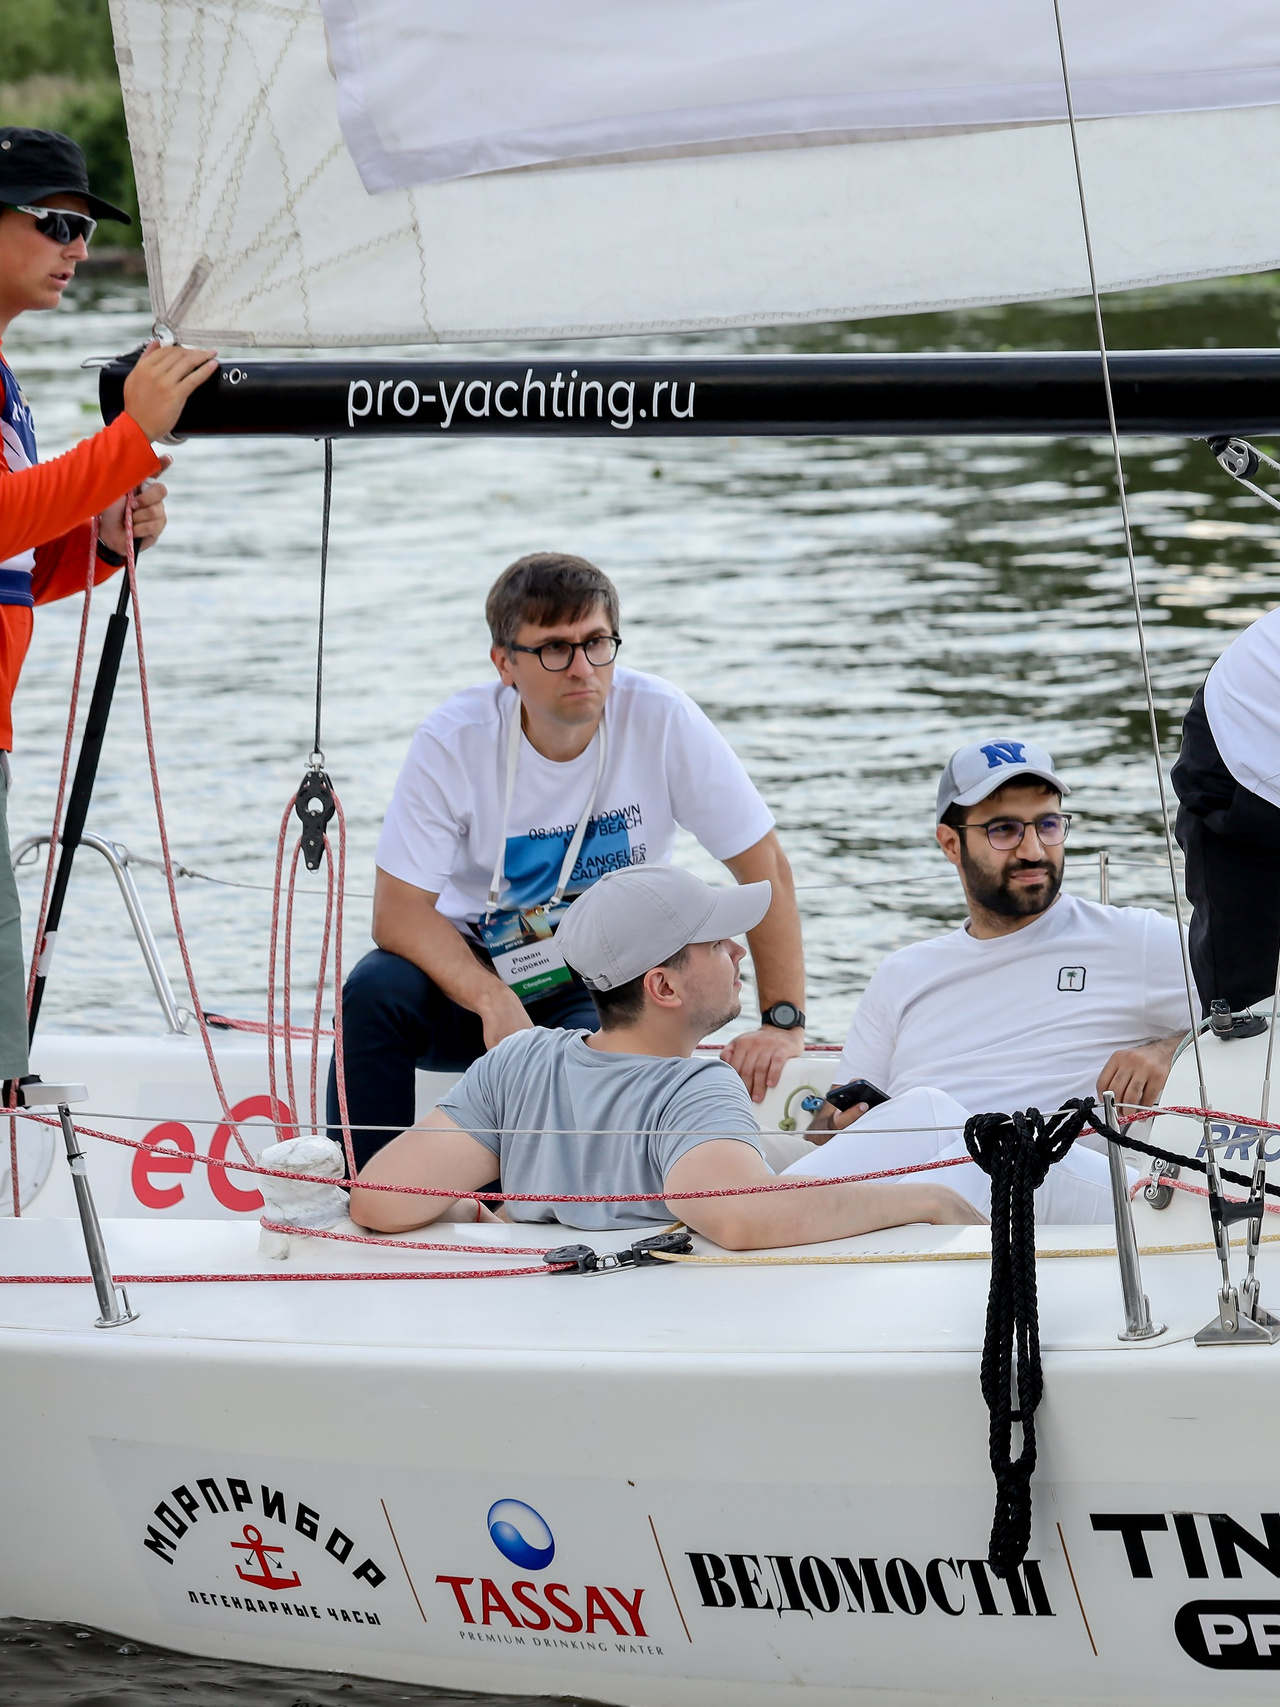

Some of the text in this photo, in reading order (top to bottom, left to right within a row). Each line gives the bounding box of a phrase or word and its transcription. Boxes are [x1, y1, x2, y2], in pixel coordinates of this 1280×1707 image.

[347, 368, 696, 430] pro-yachting.ru
[979, 742, 1027, 769] NY
[528, 825, 564, 841] 08:00
[598, 814, 643, 837] BEACH
[585, 843, 647, 870] ANGELES
[510, 957, 550, 975] Сорокин
[511, 950, 541, 965] Роман
[143, 1477, 387, 1588] МОРПРИБОР
[684, 1551, 1057, 1621] ВЕДОМОСТИ
[188, 1590, 382, 1626] ЛЕГЕНДАРНЫЕ ЧАСЫ
[435, 1575, 650, 1637] TASSAY
[459, 1630, 665, 1656] PREMIUM DRINKING WATER
